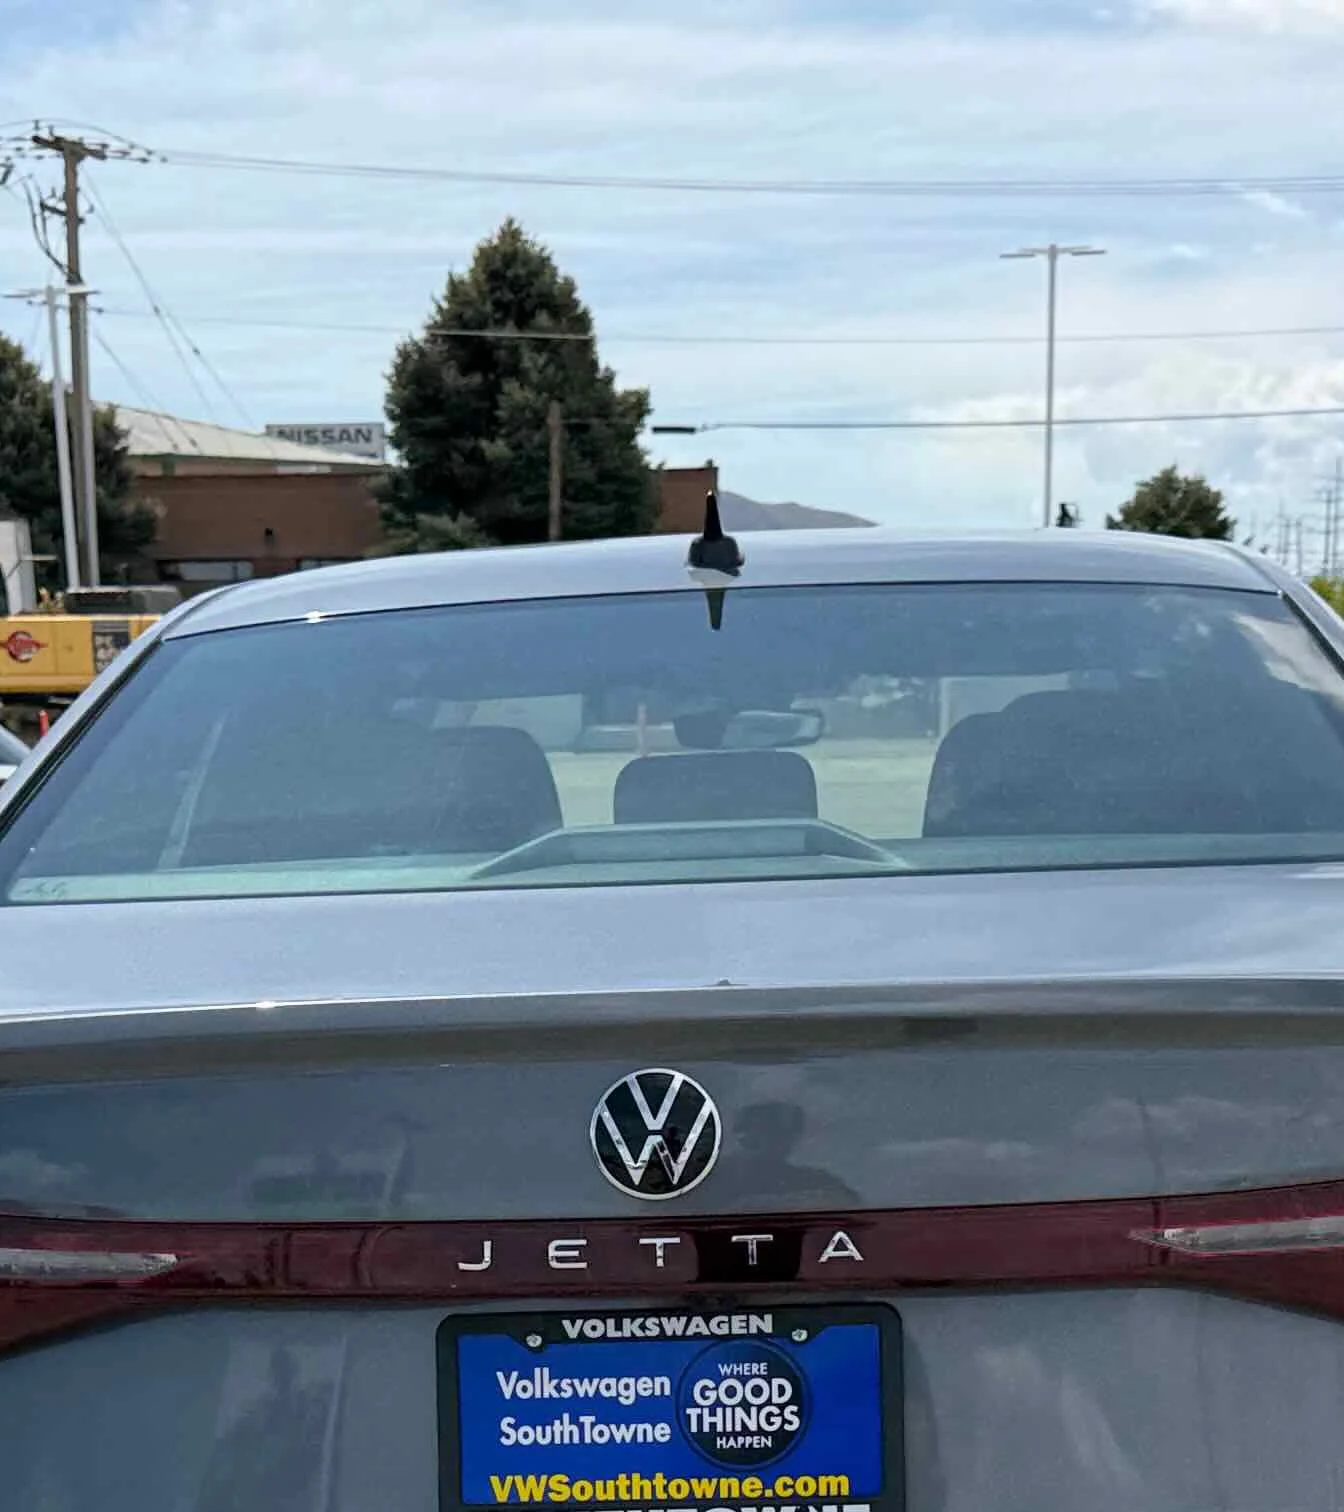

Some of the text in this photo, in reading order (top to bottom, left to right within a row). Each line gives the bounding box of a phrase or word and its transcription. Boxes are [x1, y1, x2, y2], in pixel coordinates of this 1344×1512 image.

[277, 427, 373, 446] NISSAN
[590, 1068, 722, 1200] VW
[457, 1231, 864, 1272] JETTA
[561, 1313, 773, 1339] VOLKSWAGEN
[718, 1361, 768, 1377] WHERE
[496, 1366, 672, 1406] Volkswagen
[692, 1377, 793, 1406] GOOD
[499, 1412, 672, 1446] SouthTowne
[685, 1404, 801, 1434] THINGS
[716, 1435, 773, 1449] HAPPEN
[488, 1471, 850, 1504] VWSouthtowne.com
